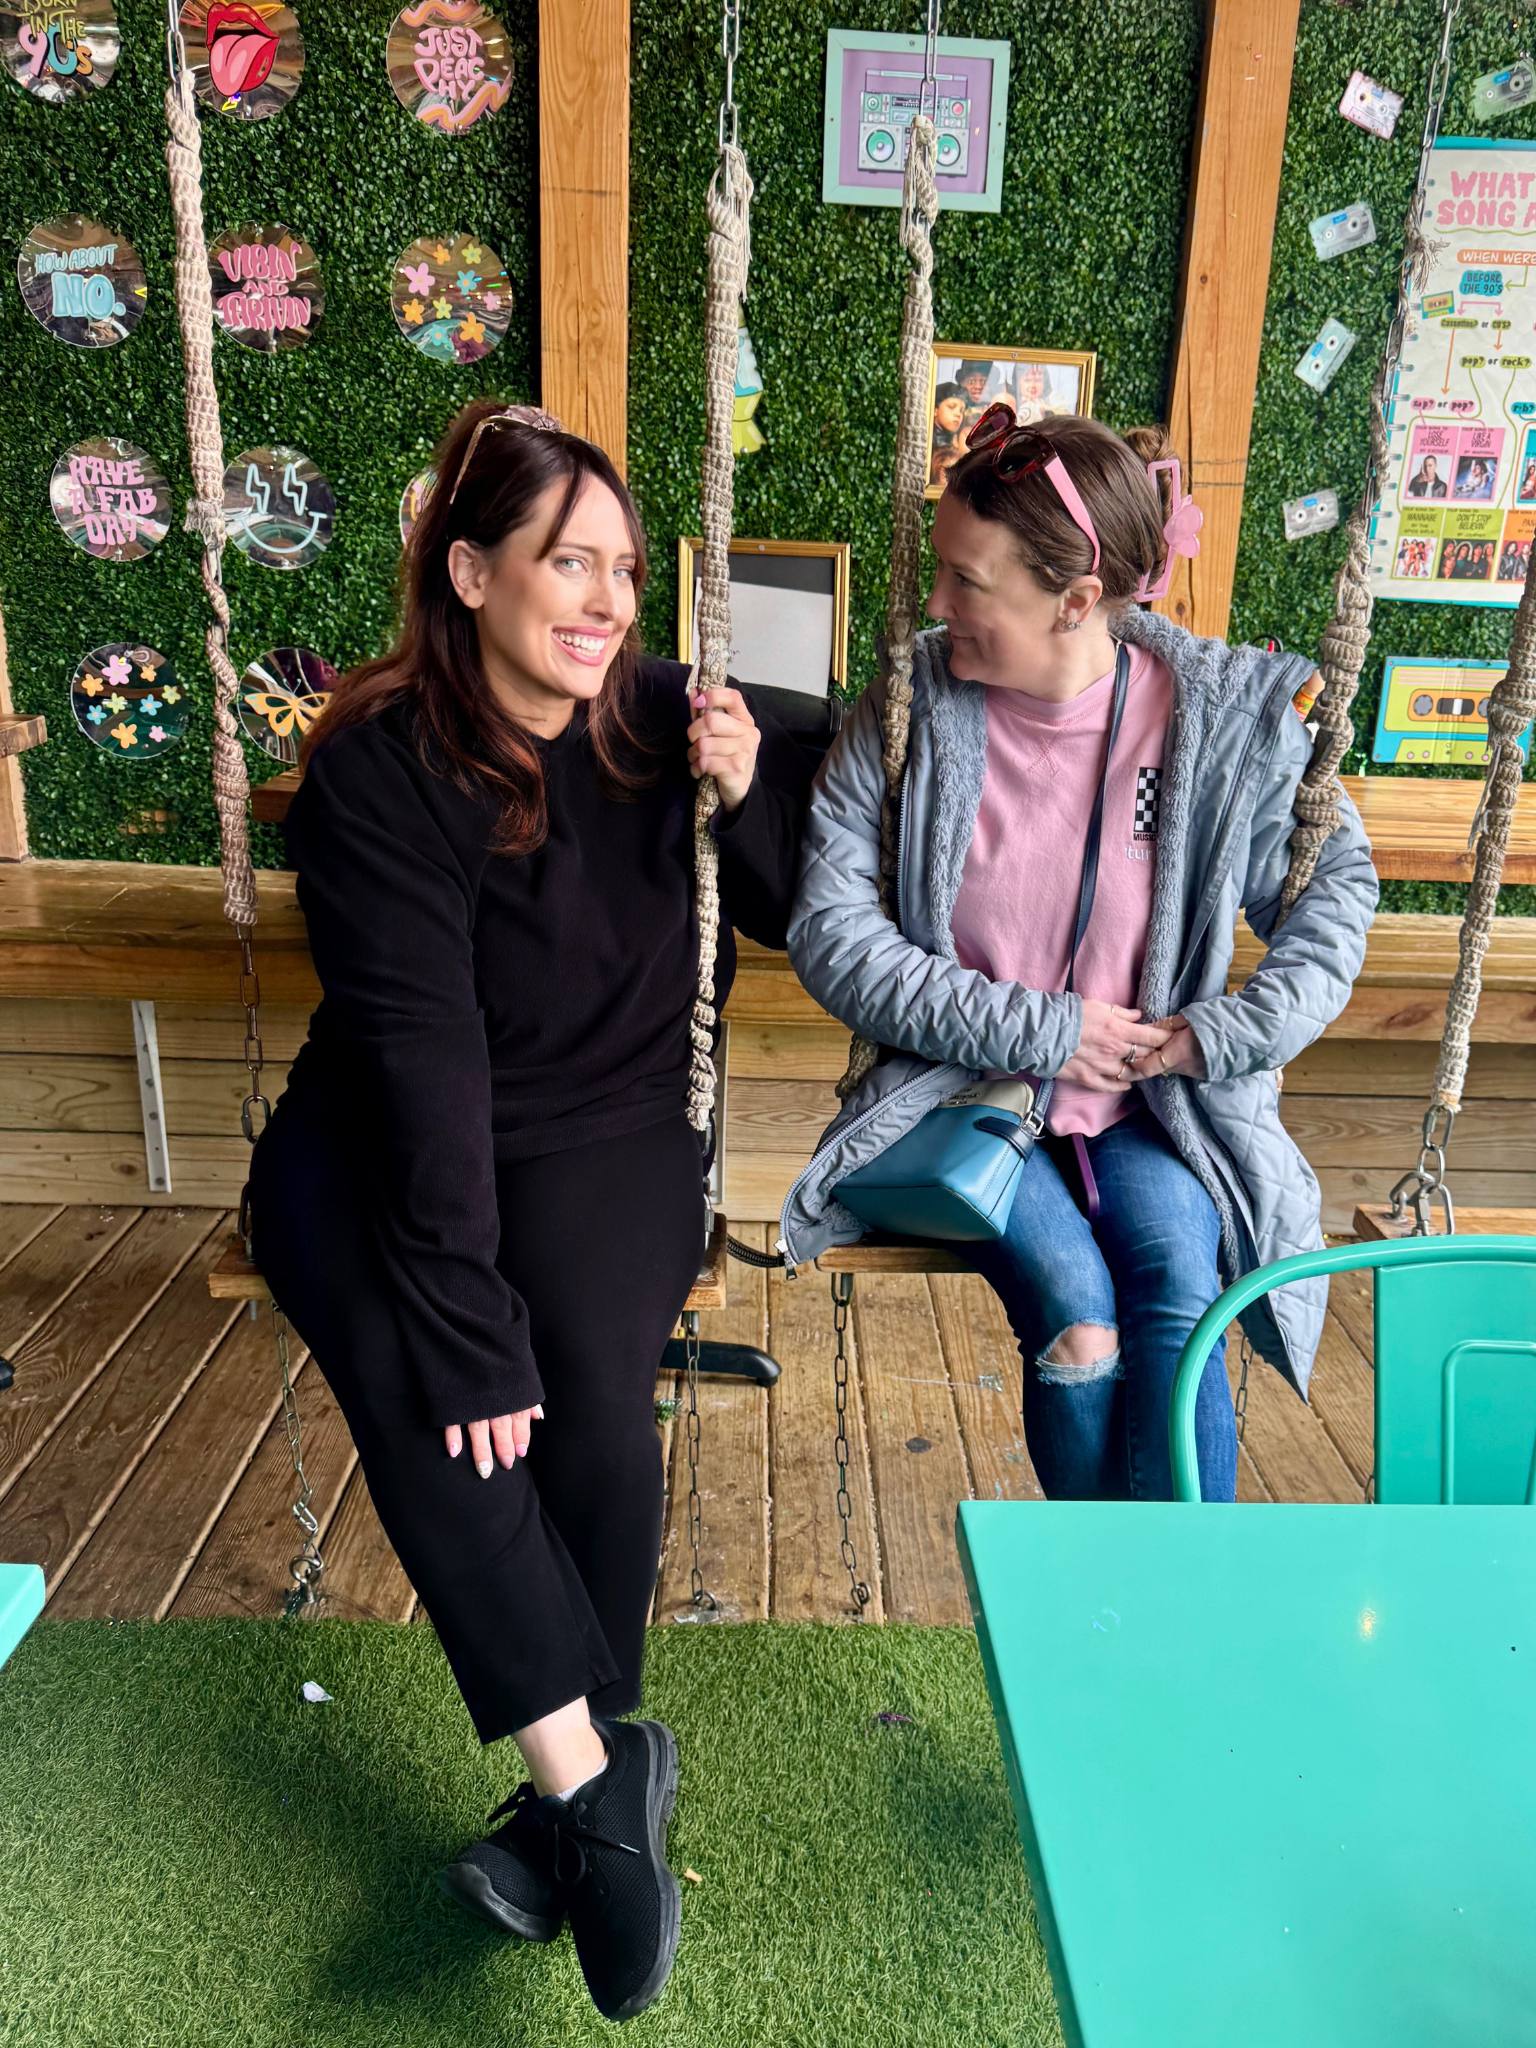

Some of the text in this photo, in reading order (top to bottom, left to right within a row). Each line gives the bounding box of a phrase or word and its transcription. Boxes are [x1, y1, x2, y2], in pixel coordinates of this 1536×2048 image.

[16, 9, 86, 45] IN THE
[414, 27, 483, 57] JUST
[414, 57, 485, 93] PEAC
[438, 79, 475, 101] HY
[1450, 170, 1535, 199] WHAT
[1436, 199, 1516, 227] SONG
[35, 243, 118, 273] HOW ABOUT
[1462, 251, 1499, 263] WHEN
[242, 279, 289, 296] AND
[1463, 284, 1481, 294] THE
[1466, 271, 1501, 283] BEFORE
[51, 271, 127, 320] NO.
[216, 291, 311, 331] THRIVIN
[1461, 356, 1485, 368] pop?
[1501, 357, 1530, 367] rock?
[69, 455, 145, 486] HAVE
[69, 485, 157, 515] A FAB
[83, 514, 137, 545] DAY
[1133, 833, 1157, 841] MUSIC
